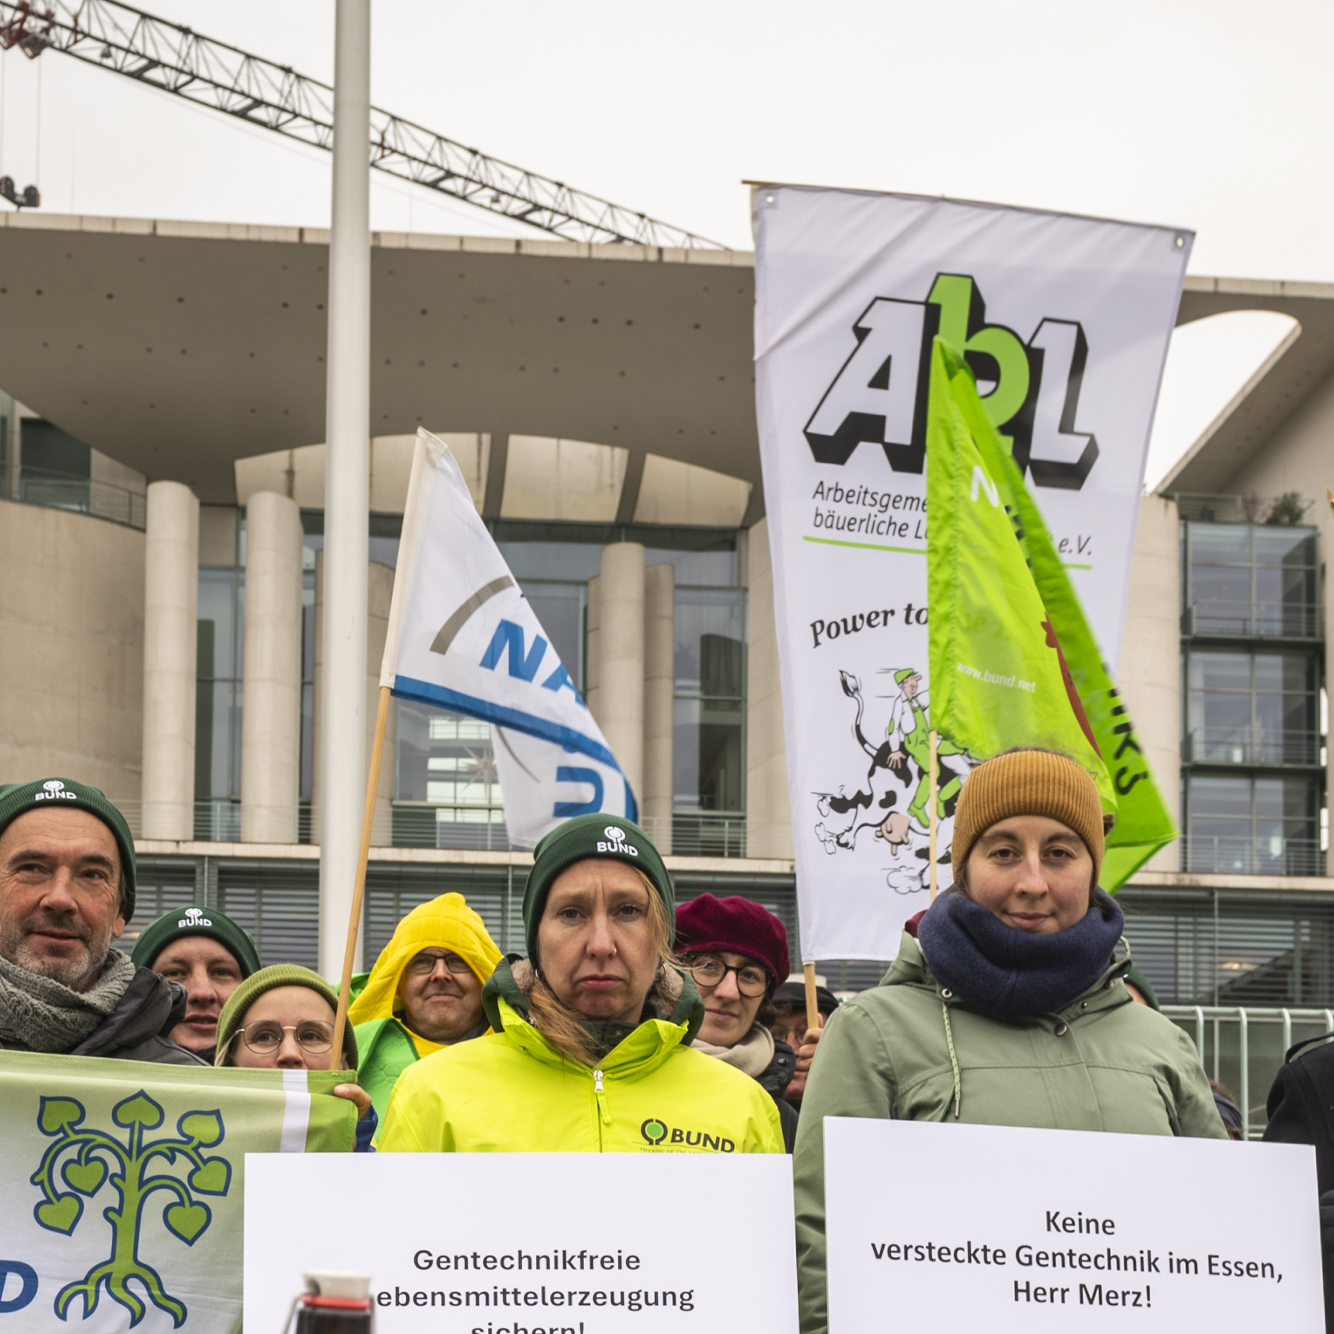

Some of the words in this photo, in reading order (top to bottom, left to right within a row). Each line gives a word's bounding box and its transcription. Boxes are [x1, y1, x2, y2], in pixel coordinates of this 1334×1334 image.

[812, 480, 928, 513] Arbeitsgeme
[814, 507, 909, 538] bäuerliche
[1058, 535, 1093, 556] e.V.
[810, 608, 895, 649] Power
[956, 661, 1037, 694] www.bund.net
[35, 791, 77, 801] BUND
[597, 841, 639, 857] BUND
[178, 917, 213, 928] BUND
[671, 1128, 735, 1153] BUND
[1045, 1210, 1116, 1236] Keine
[413, 1249, 641, 1272] Gentechnikfreie
[870, 1240, 1007, 1267] versteckte
[1015, 1245, 1161, 1274] Gentechnik
[1168, 1251, 1199, 1275] im
[1206, 1254, 1284, 1284] Essen,
[375, 1286, 695, 1312] ebensmittelerzeugung
[1013, 1280, 1070, 1305] Herr
[1078, 1283, 1153, 1308] Merz!
